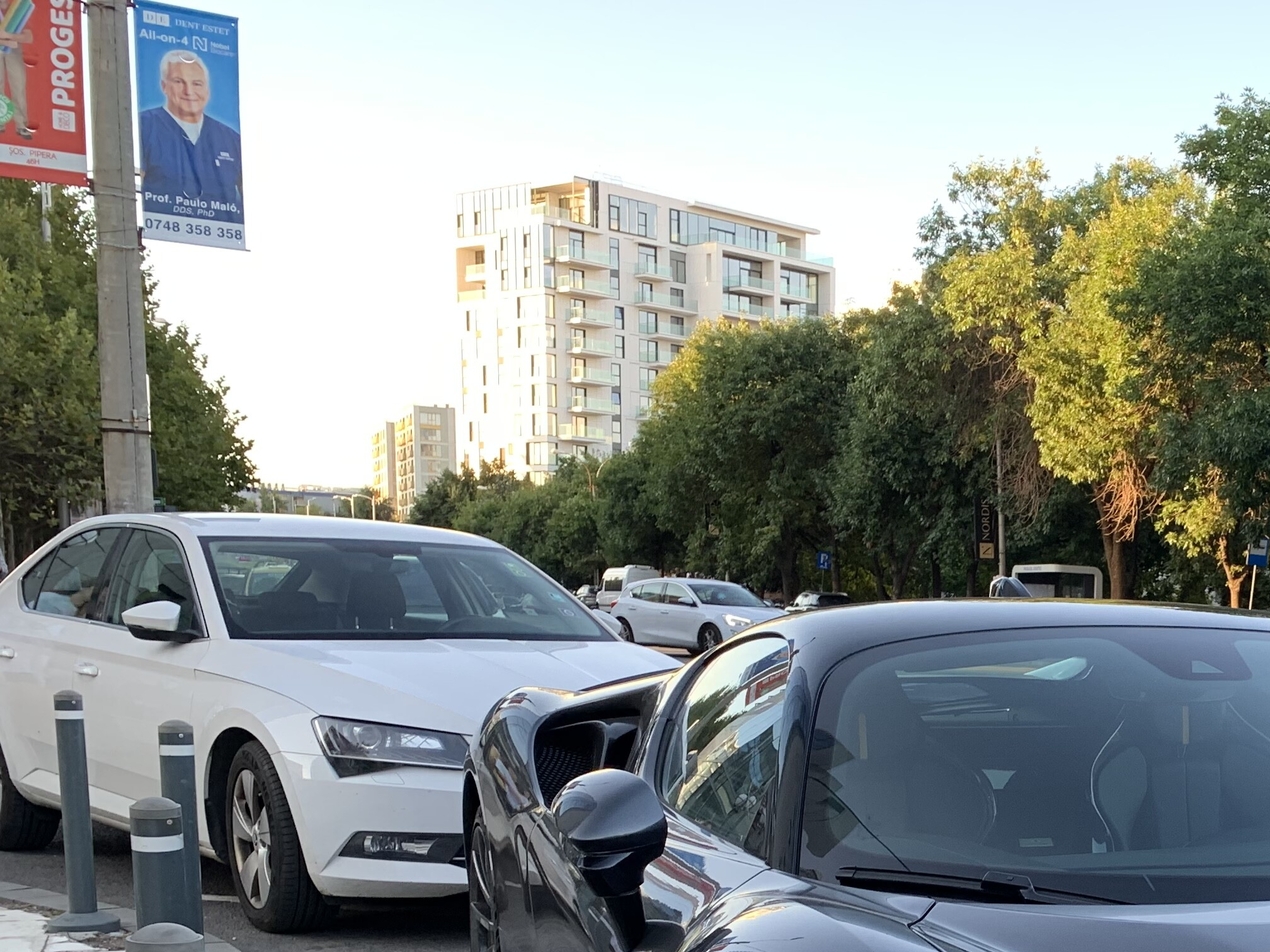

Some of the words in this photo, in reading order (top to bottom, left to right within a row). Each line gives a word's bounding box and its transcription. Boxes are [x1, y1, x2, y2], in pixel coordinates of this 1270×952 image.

[175, 18, 200, 30] DENT
[202, 24, 230, 36] ESTET
[139, 28, 188, 46] All-on-4
[30, 150, 58, 160] PIPERA
[144, 192, 172, 204] Prof.
[176, 196, 207, 208] Paulo
[211, 201, 240, 214] Maló,
[197, 208, 215, 218] PhD
[145, 218, 180, 232] 0748
[186, 224, 212, 236] 358
[217, 228, 242, 240] 358
